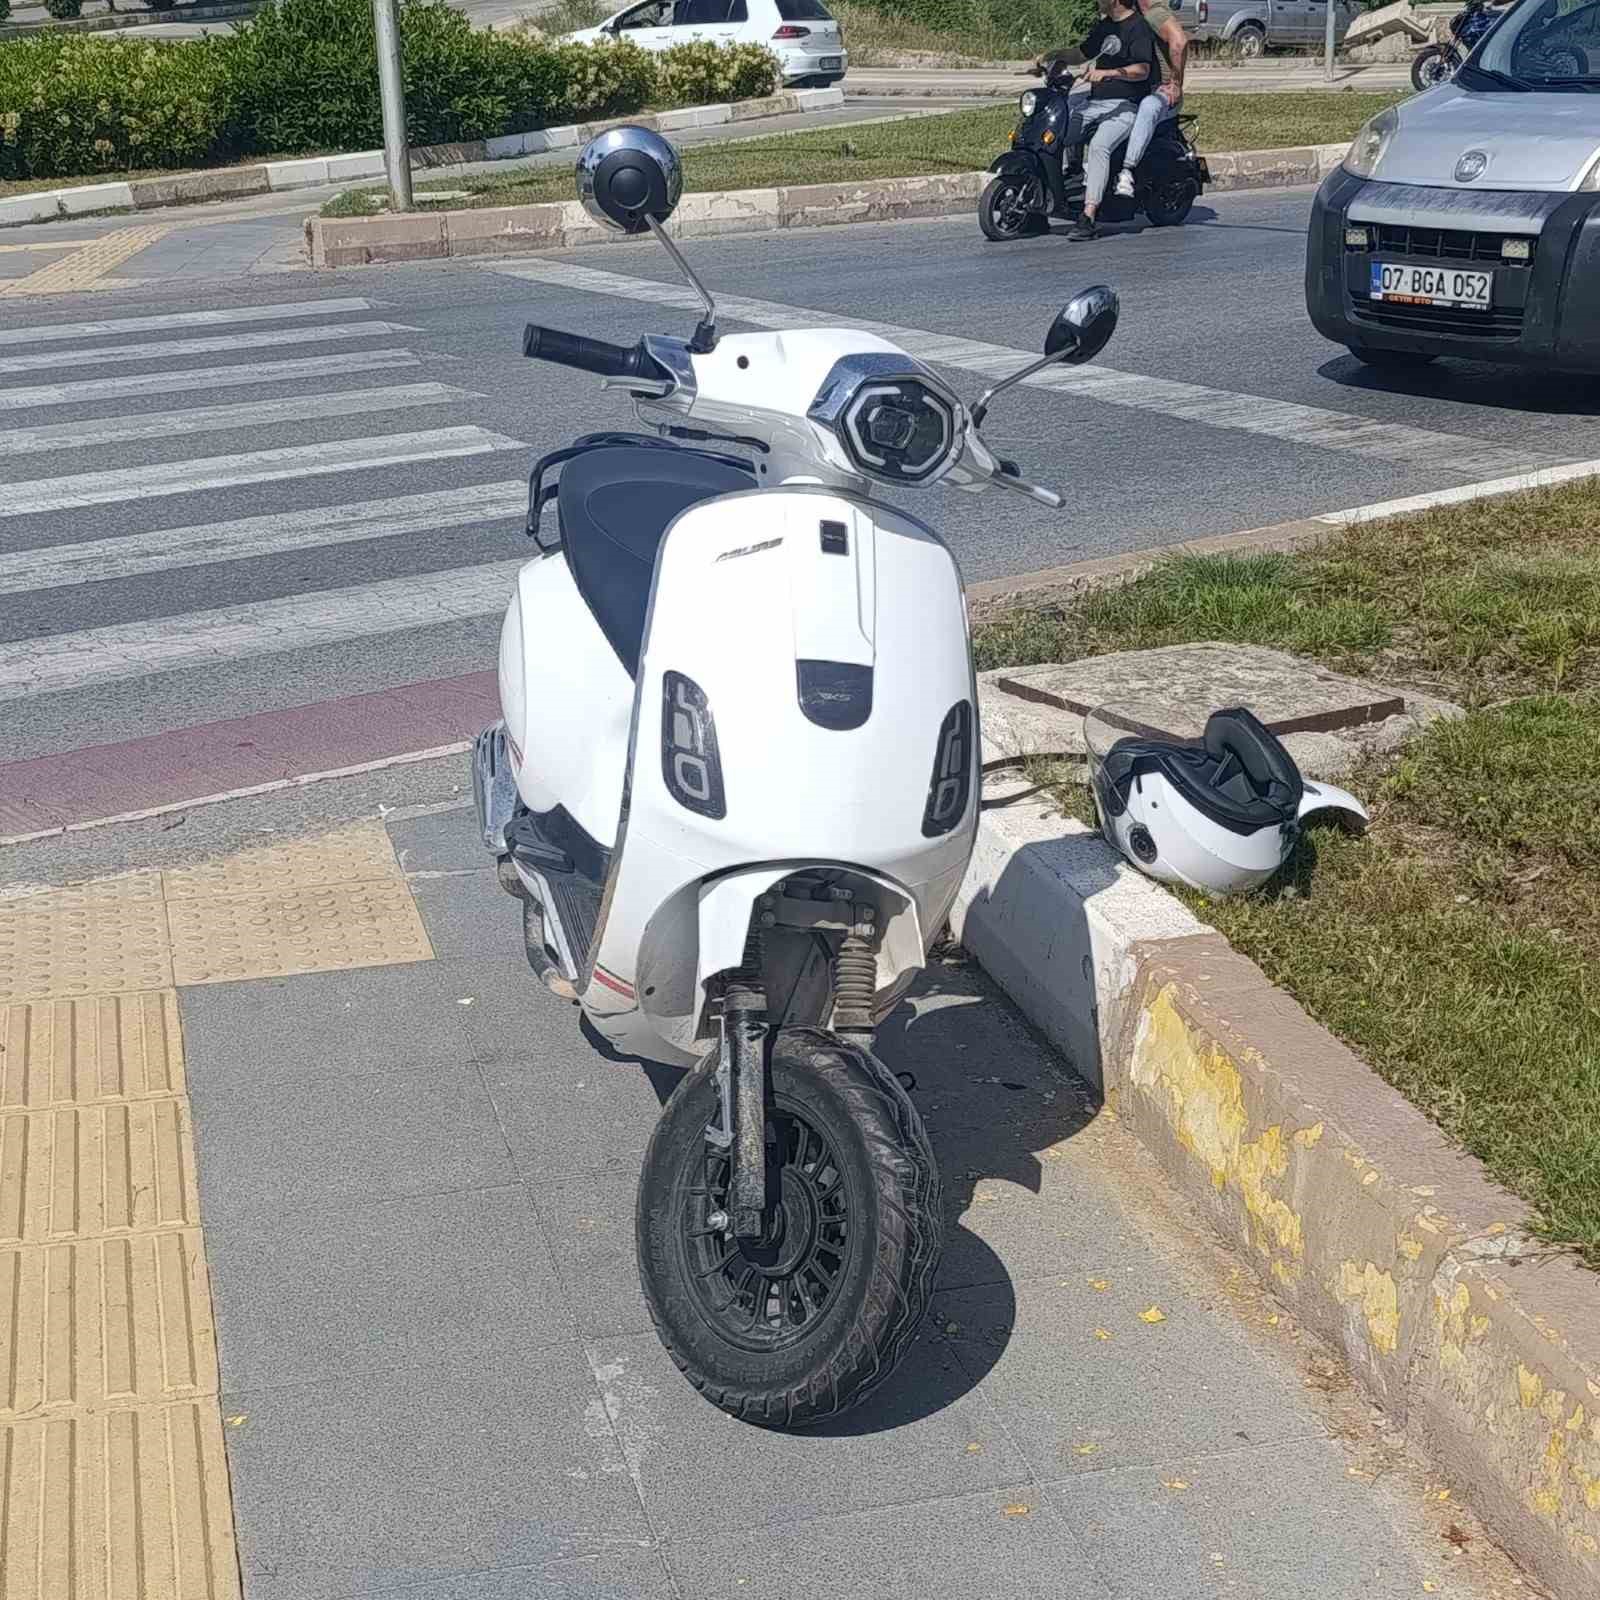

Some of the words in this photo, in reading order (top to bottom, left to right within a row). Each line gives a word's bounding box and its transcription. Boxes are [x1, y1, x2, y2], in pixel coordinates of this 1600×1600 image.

[1382, 267, 1404, 291] 07
[1411, 269, 1446, 296] BGA
[1453, 273, 1488, 300] 052
